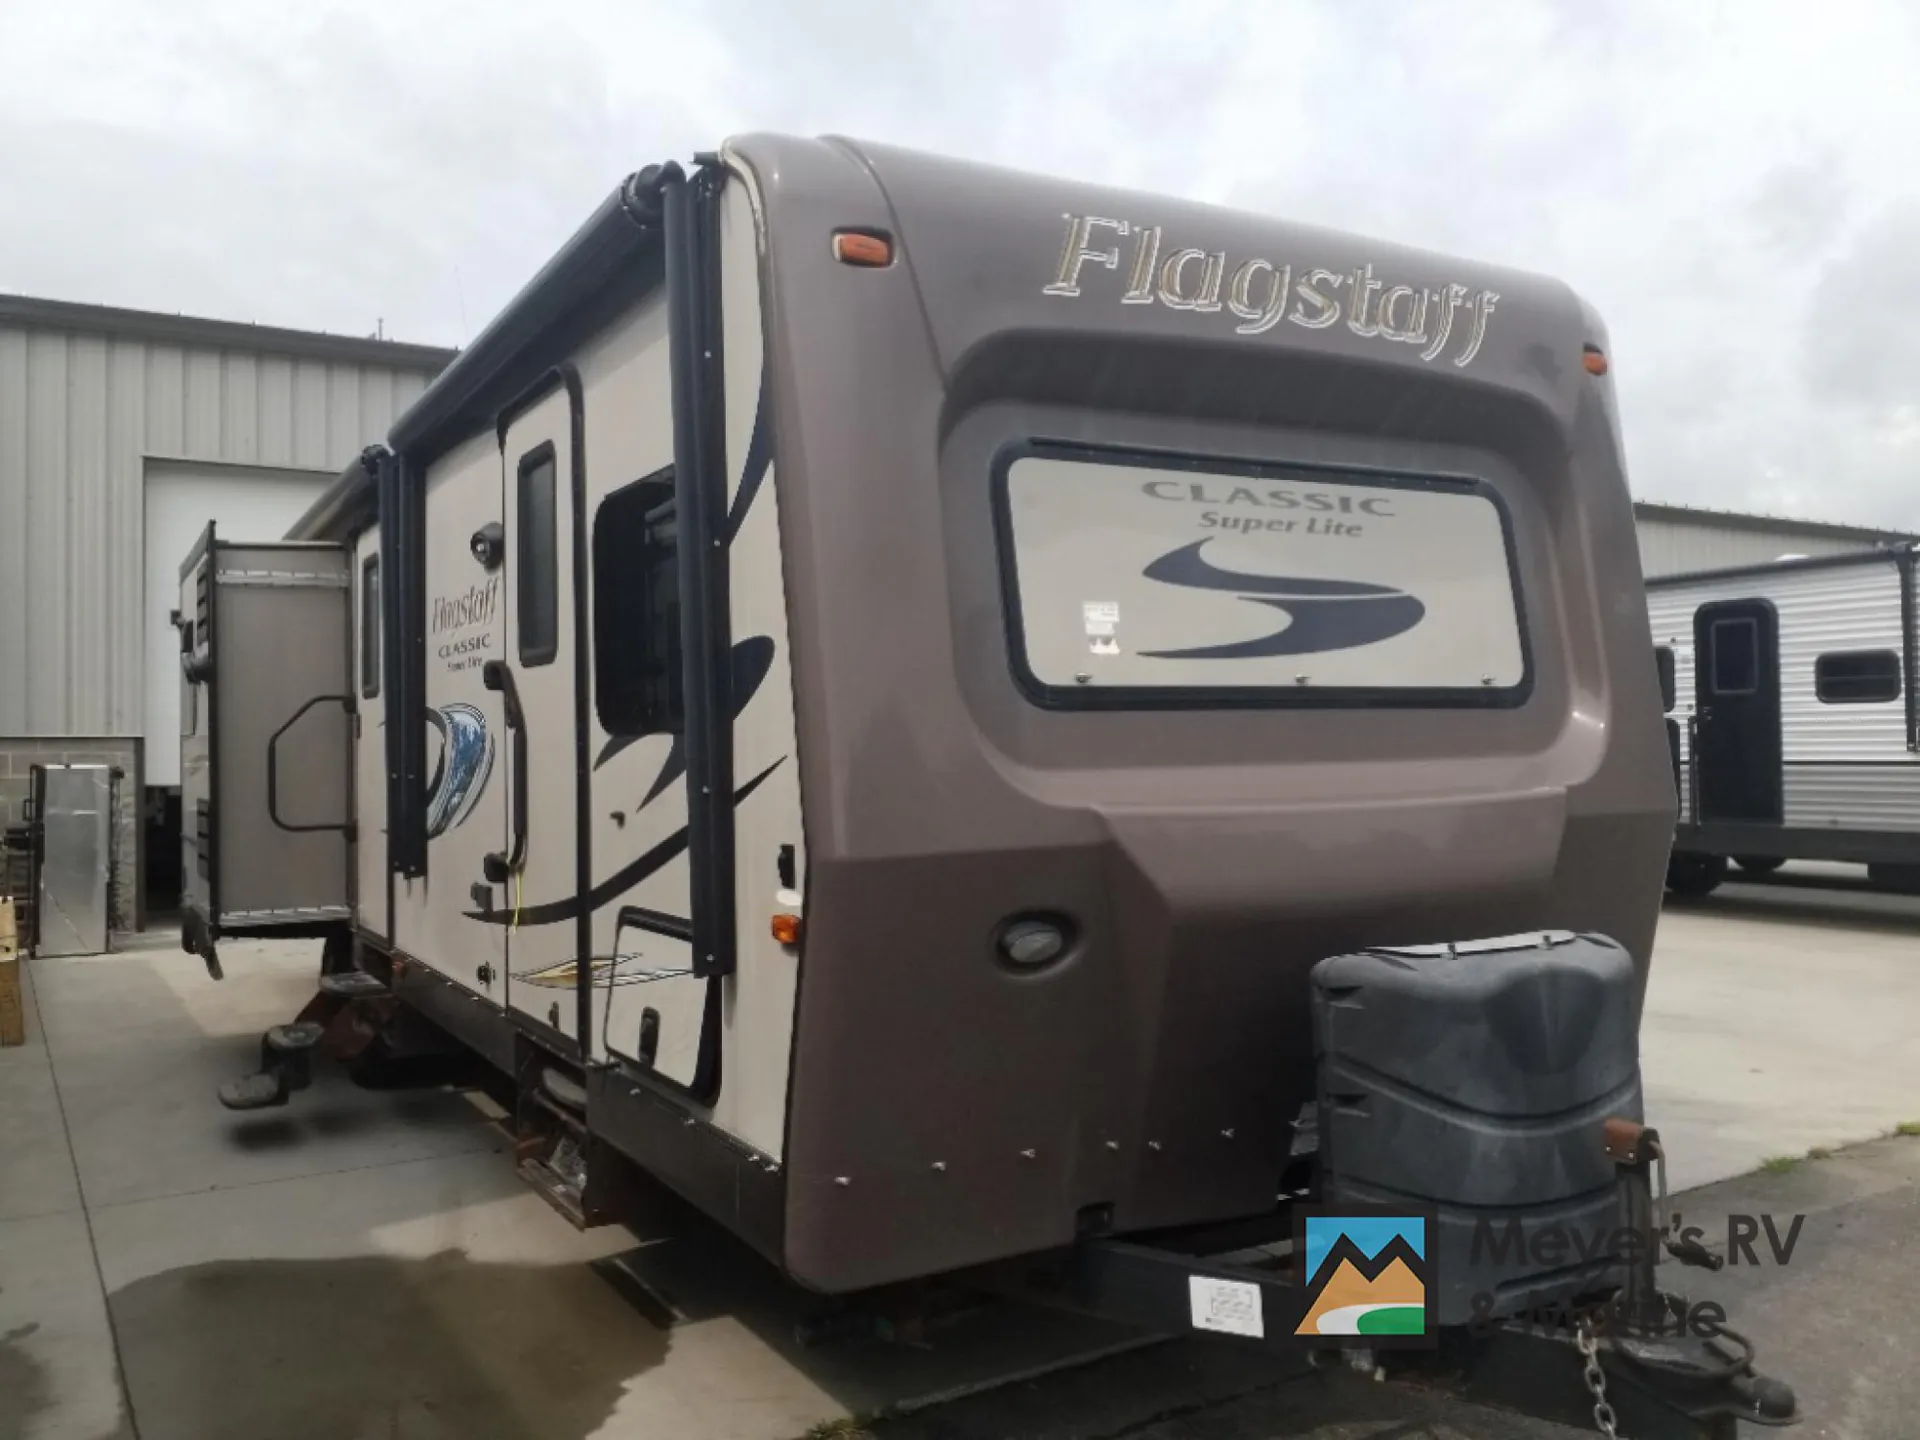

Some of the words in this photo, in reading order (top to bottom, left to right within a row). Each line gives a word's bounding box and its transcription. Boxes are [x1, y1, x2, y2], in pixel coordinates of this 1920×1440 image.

[1042, 212, 1501, 368] Flagstaff
[1141, 481, 1396, 517] CLASSIC
[1198, 511, 1299, 535] Super
[1305, 517, 1363, 538] Lite
[438, 633, 491, 659] CLASSIC
